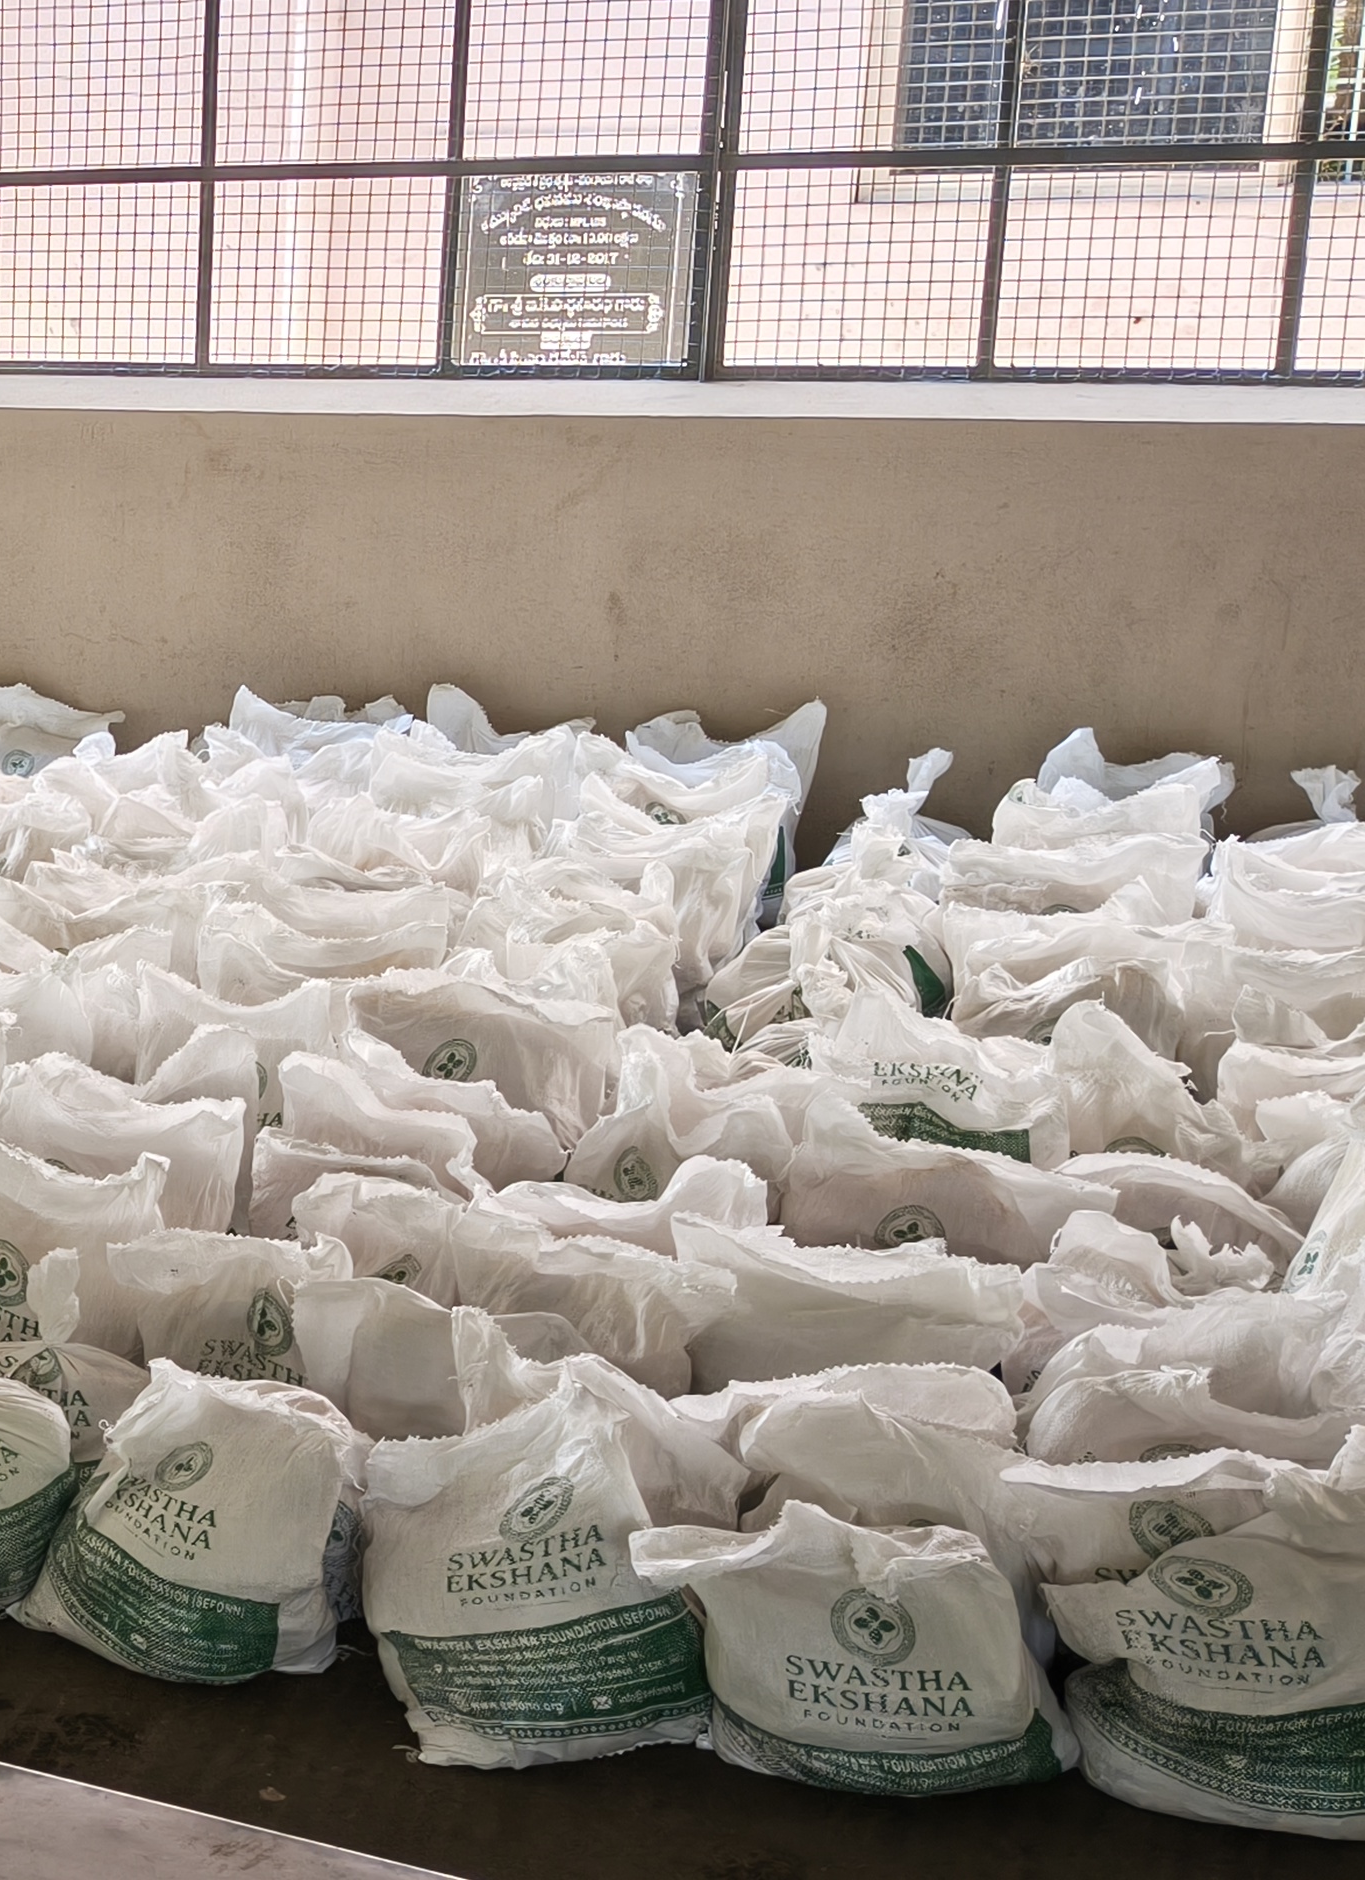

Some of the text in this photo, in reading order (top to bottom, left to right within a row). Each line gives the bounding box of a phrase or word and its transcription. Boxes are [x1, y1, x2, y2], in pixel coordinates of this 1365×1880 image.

[203, 1338, 305, 1386] SWASTH
[117, 1490, 212, 1550] SHANA
[119, 1476, 218, 1529] WASTHA
[104, 1500, 196, 1561] OUNDATION
[447, 1524, 604, 1573] SWASTHA
[446, 1548, 607, 1593] EKSHANA
[460, 1577, 596, 1606] FOUNDATION
[540, 1616, 619, 1645] FOUNDATION
[1115, 1609, 1325, 1642] SWASTHA
[1121, 1628, 1326, 1670] EKSHANA
[786, 1654, 973, 1692] SWASTHA
[1144, 1654, 1311, 1686] FOUNDATION
[786, 1679, 976, 1718] EKSHANA
[803, 1708, 961, 1732] FOUNDATION
[881, 1755, 968, 1773] FOUNDATION
